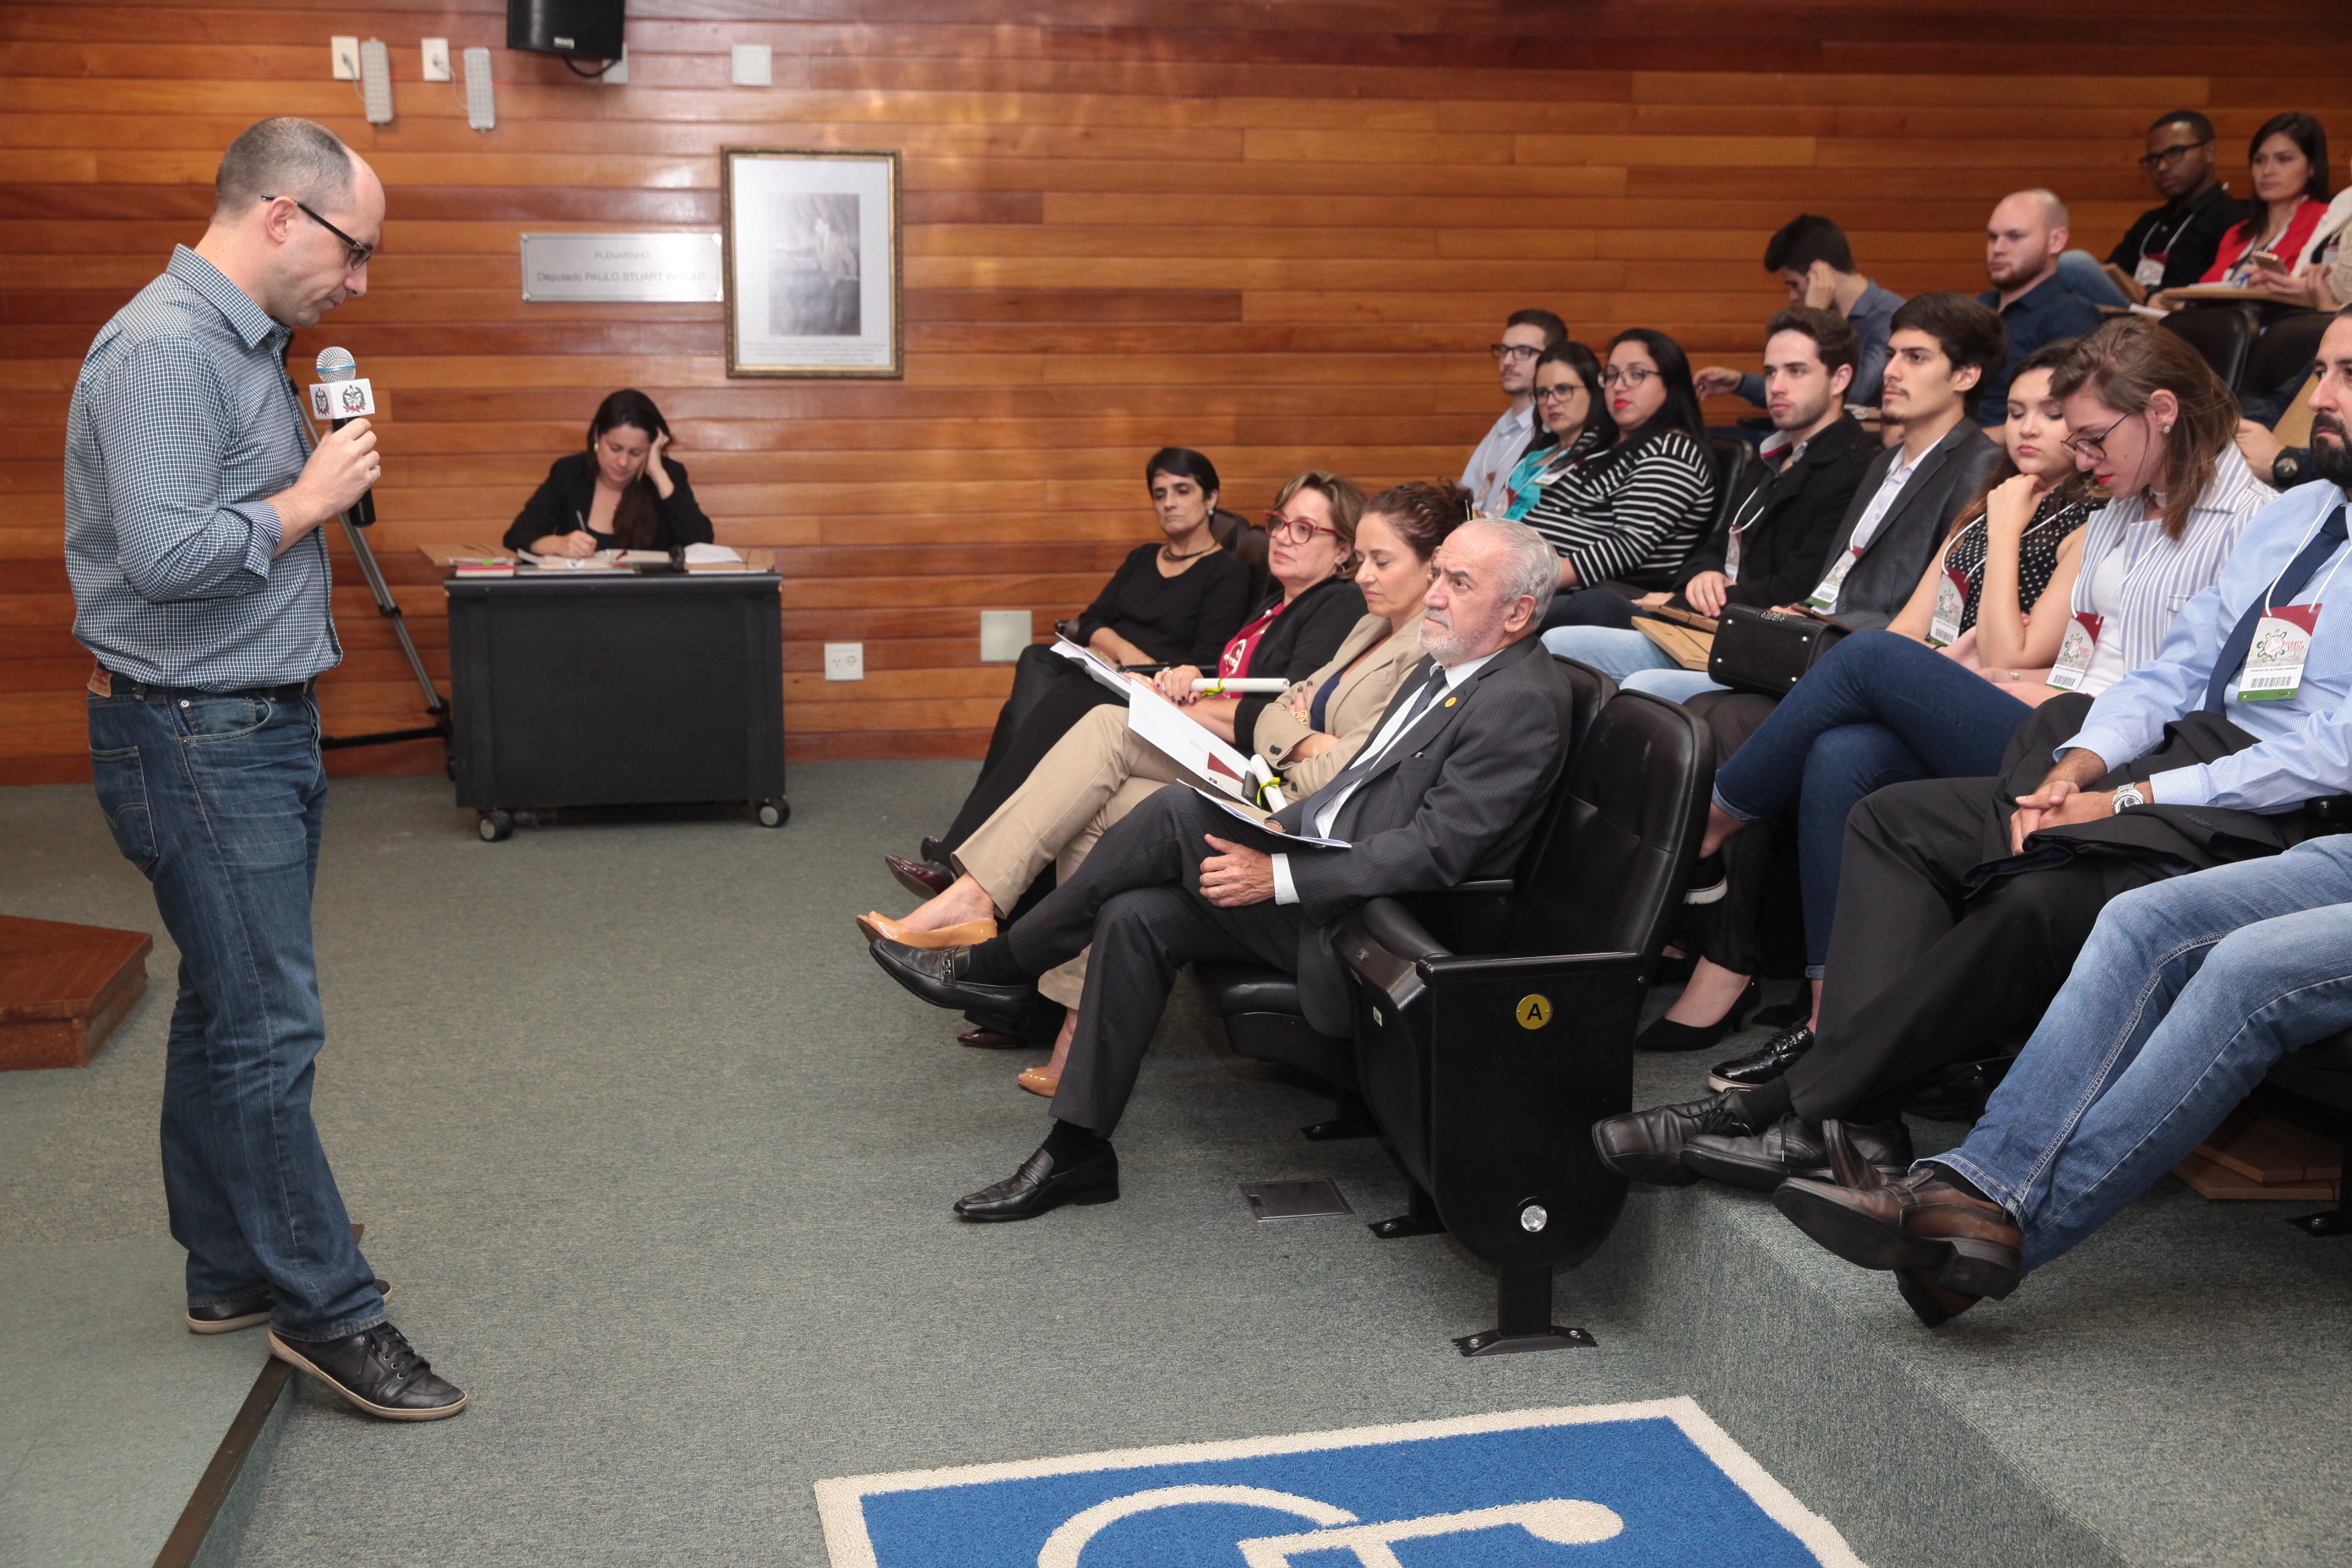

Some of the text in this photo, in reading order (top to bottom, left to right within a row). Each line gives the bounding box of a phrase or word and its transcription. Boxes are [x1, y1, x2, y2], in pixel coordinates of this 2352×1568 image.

[536, 271, 583, 284] Deputado
[585, 271, 619, 283] PAULO
[623, 271, 664, 283] STUART
[1527, 1003, 1543, 1020] A
